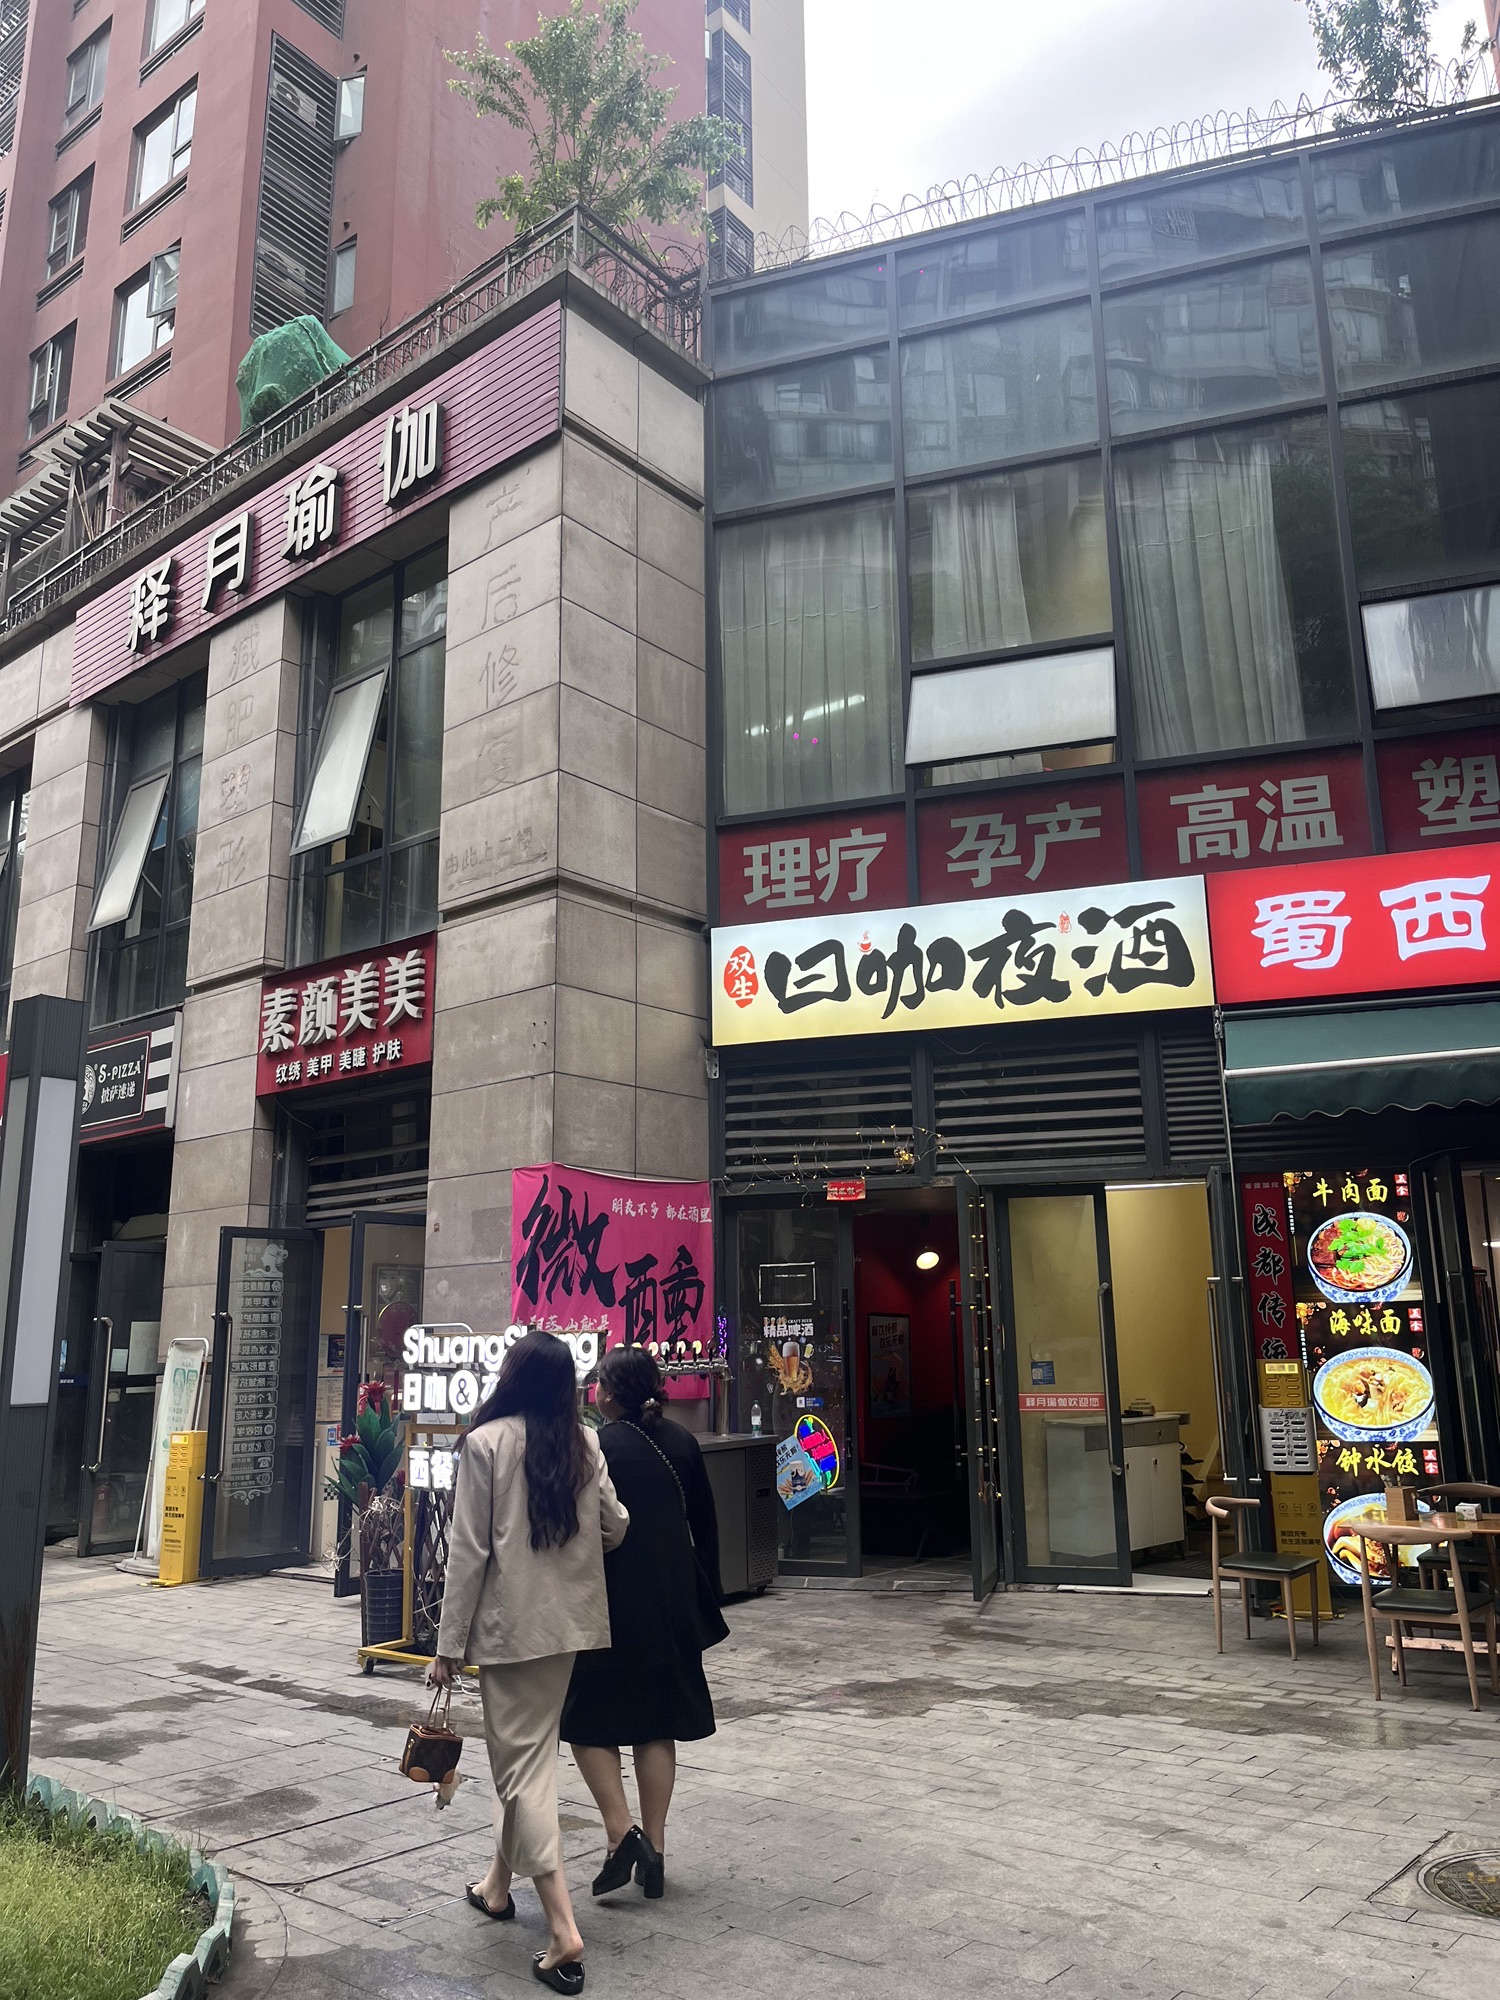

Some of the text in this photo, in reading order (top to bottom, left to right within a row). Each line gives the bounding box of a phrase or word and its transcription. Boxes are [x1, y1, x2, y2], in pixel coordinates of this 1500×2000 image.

[125, 400, 445, 656] 释月瑜伽
[743, 828, 887, 910] 理疗
[946, 802, 1102, 887] 孕产
[1169, 775, 1345, 866] 高温
[1250, 874, 1491, 970] 蜀西
[728, 950, 757, 1001] 双生
[764, 902, 1196, 1019] 日咖夜酒
[259, 949, 428, 1054] 素颜美美
[98, 1059, 142, 1084] S-PIZZA
[275, 1038, 403, 1085] 纹绣 美甲 美睫 护肤
[611, 1197, 713, 1223] 朋友不多 都在酒里
[1312, 1177, 1389, 1207] 牛肉面
[763, 1322, 814, 1338] 精品啤酒
[1329, 1308, 1401, 1336] 海味面
[1335, 1446, 1420, 1478] 钟水饺
